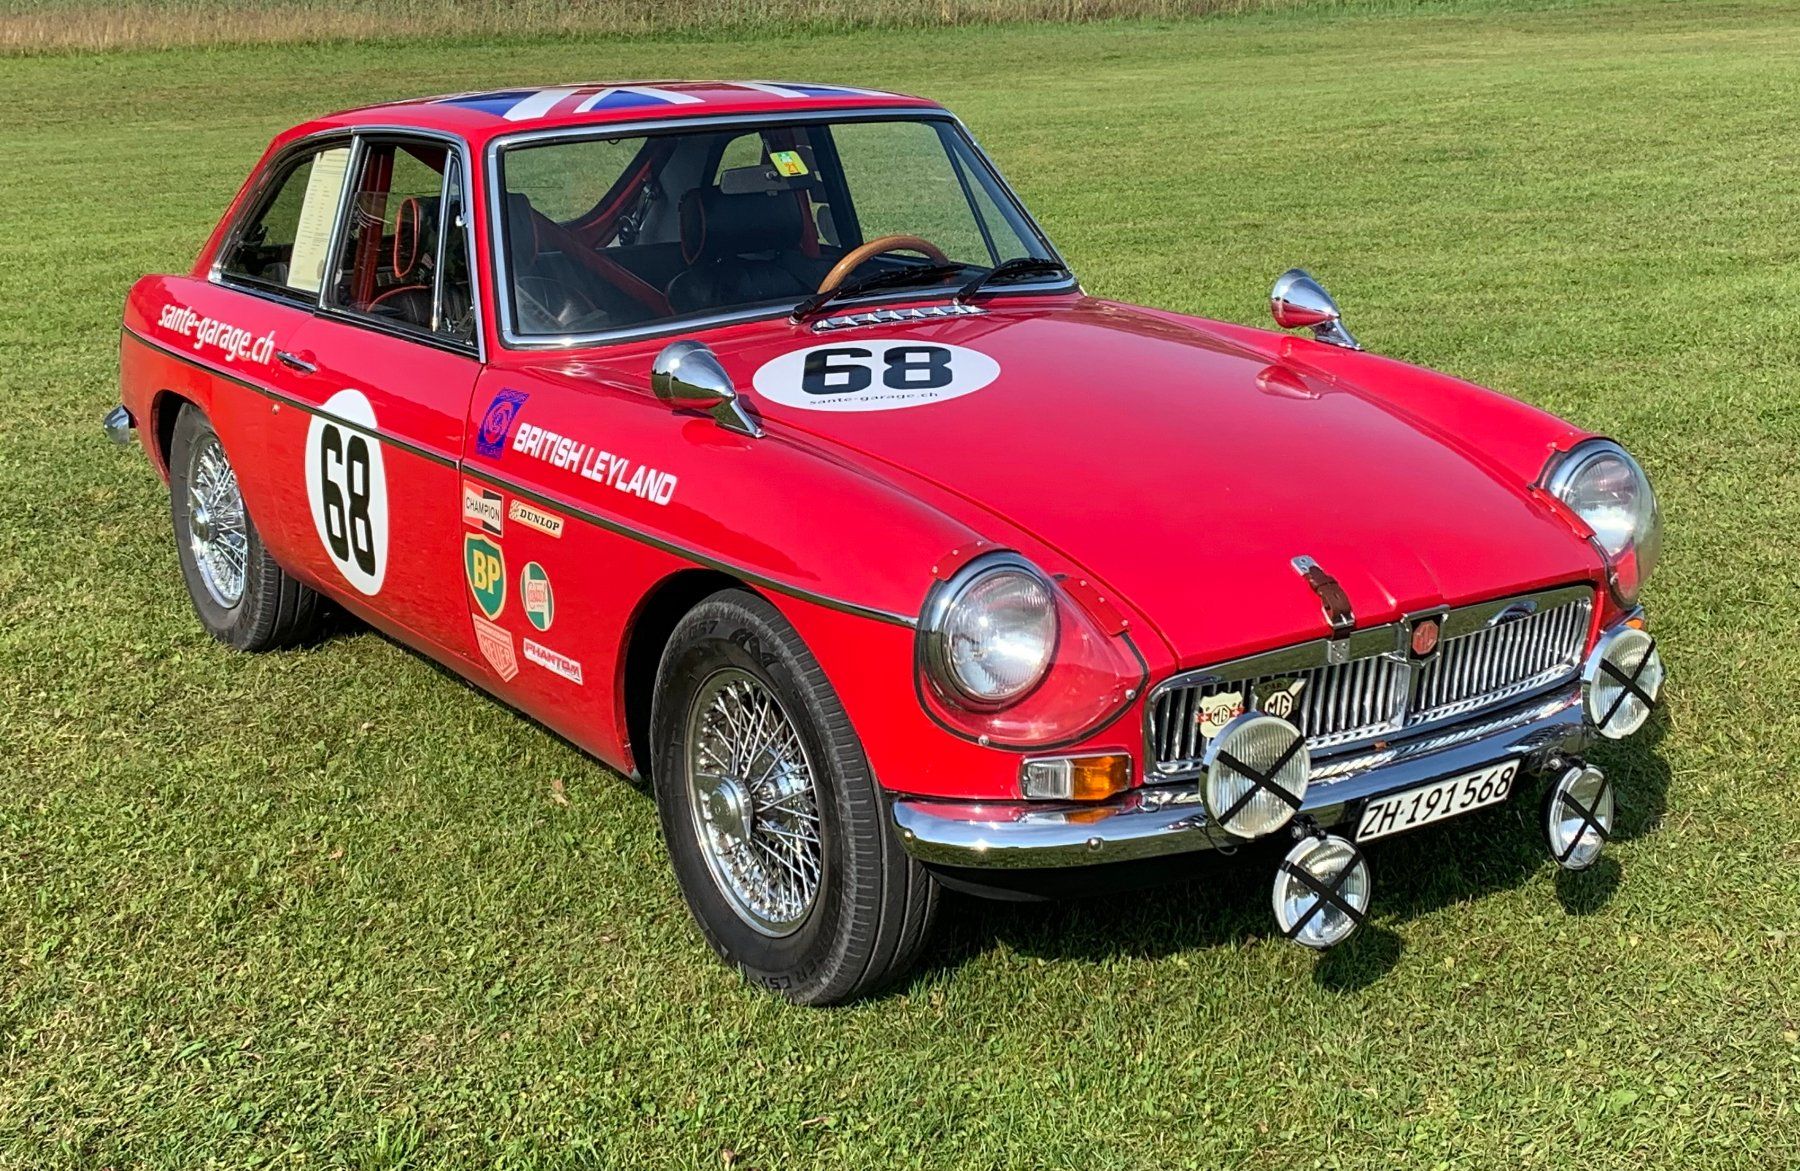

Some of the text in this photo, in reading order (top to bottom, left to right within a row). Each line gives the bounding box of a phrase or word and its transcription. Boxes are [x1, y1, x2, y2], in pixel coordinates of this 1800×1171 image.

[157, 303, 276, 365] sante-garage.ch
[801, 345, 953, 395] 68
[809, 392, 939, 405] sante-garage.ch
[512, 422, 678, 506] BRITISH LEYLAND
[320, 423, 376, 577] 68
[465, 496, 500, 521] CHAMPION
[519, 508, 560, 531] DUNLOP
[473, 548, 501, 595] BP
[524, 642, 580, 678] PHANTOM
[1212, 706, 1229, 725] MG
[1267, 693, 1291, 718] MG
